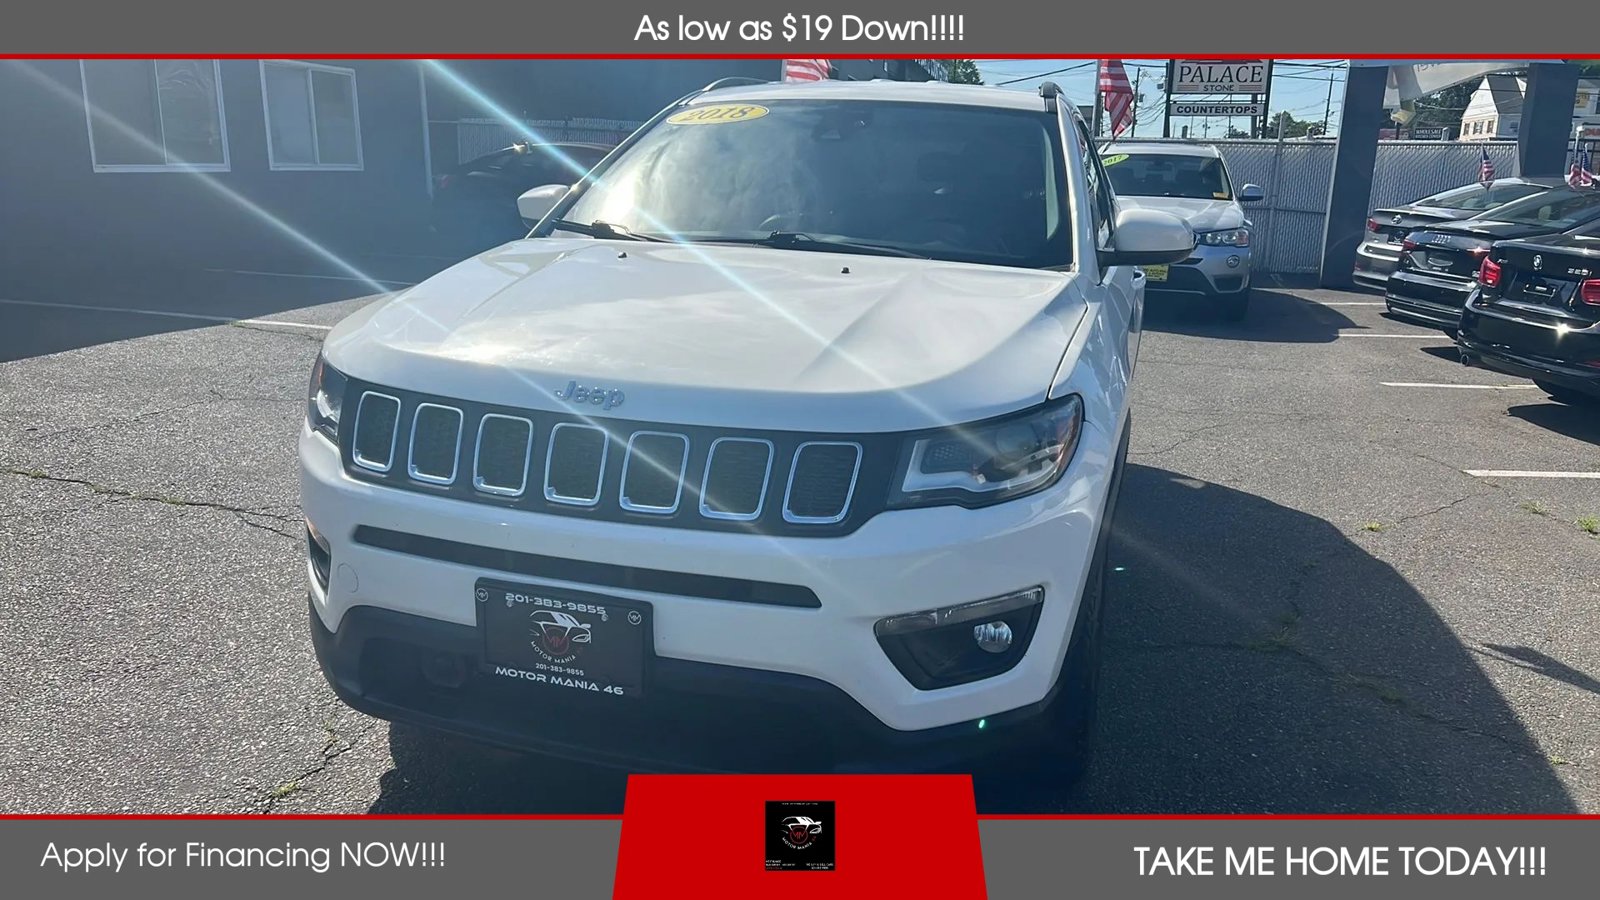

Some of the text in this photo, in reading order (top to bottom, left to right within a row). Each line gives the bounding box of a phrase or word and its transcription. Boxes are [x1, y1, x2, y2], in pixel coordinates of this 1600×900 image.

[1178, 65, 1264, 83] PALACE
[1203, 84, 1235, 92] STONE
[682, 106, 755, 121] 2018
[1176, 105, 1258, 114] COUNTERTOPS
[554, 380, 625, 411] Jeep
[505, 593, 606, 614] 201-383-9855
[530, 641, 577, 664] MOTOR MANIA
[535, 663, 584, 676] 201-383-9855
[495, 667, 624, 696] MOTOR MANIA 46
